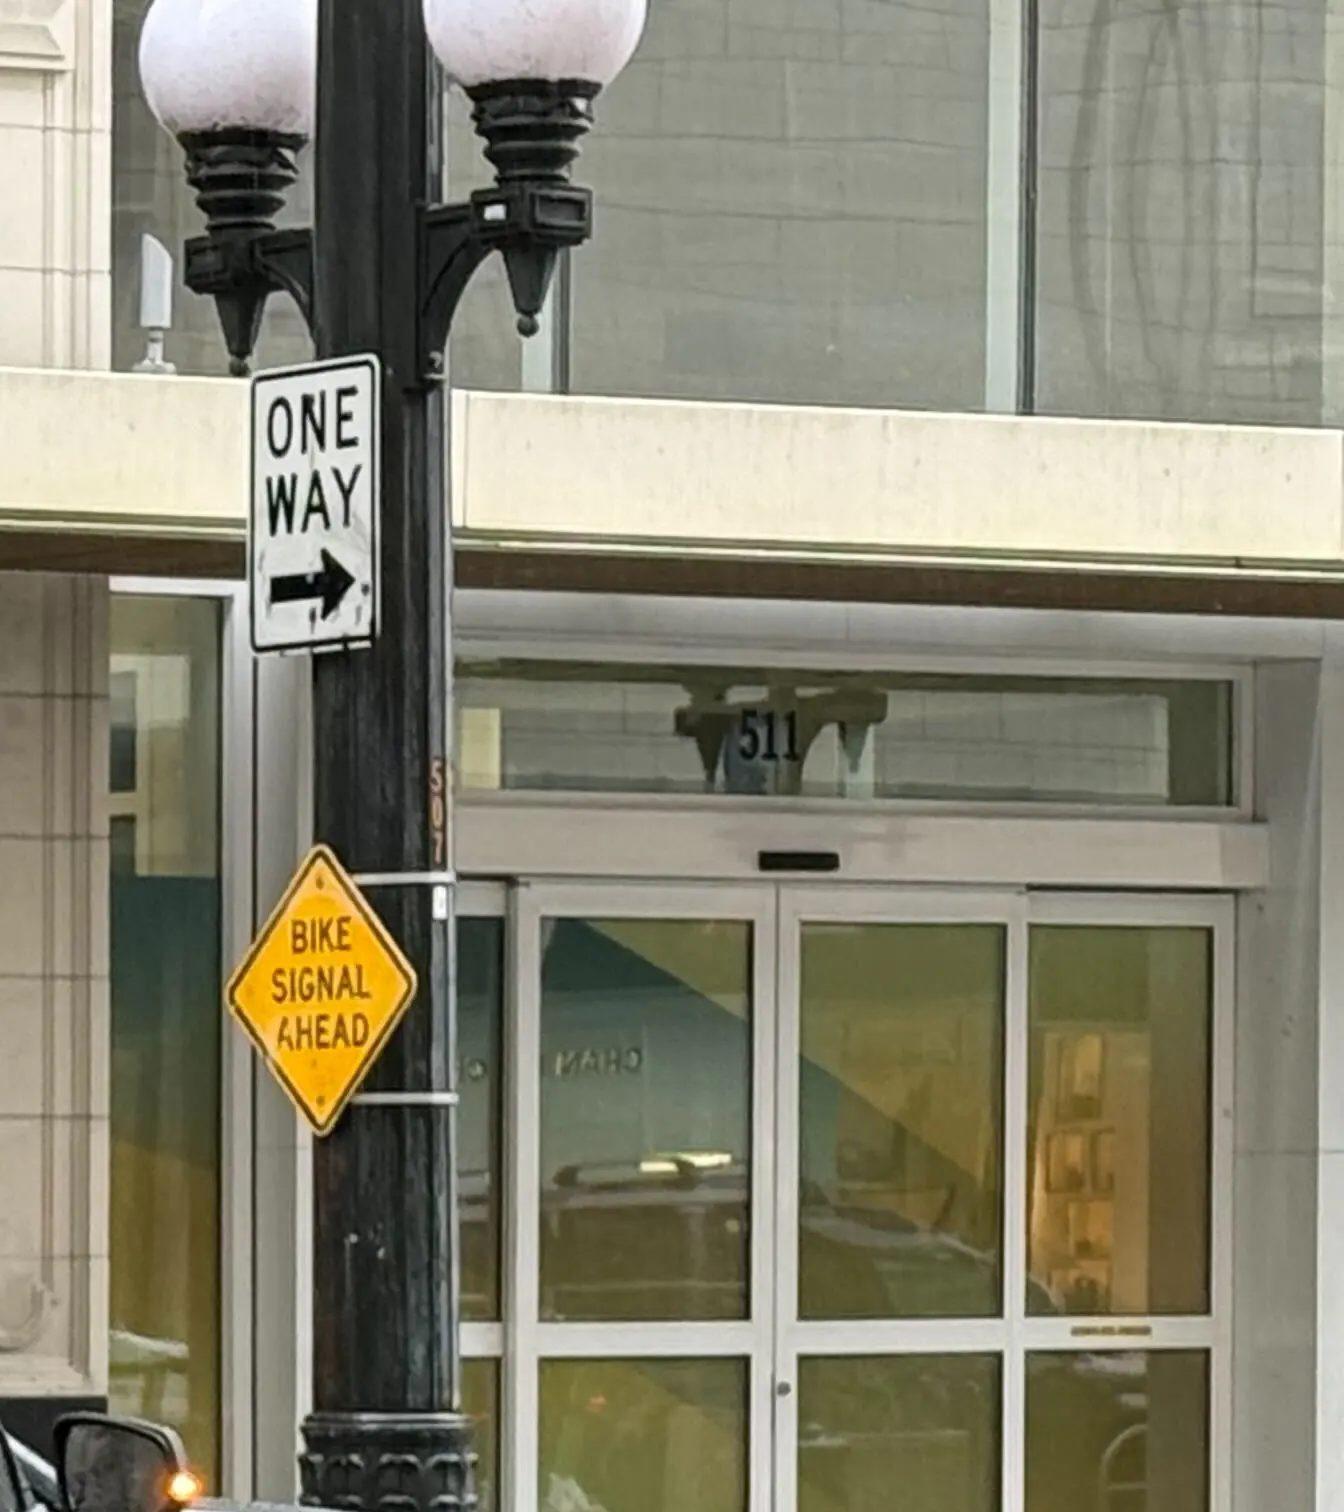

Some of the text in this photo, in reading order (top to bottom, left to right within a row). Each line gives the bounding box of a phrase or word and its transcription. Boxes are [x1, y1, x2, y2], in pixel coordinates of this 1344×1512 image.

[267, 385, 359, 458] ONE
[265, 463, 362, 537] WAY
[739, 708, 801, 761] 511
[291, 915, 352, 954] BIKE
[271, 964, 373, 1004] SIGNAL
[277, 1013, 370, 1051] AHEAD
